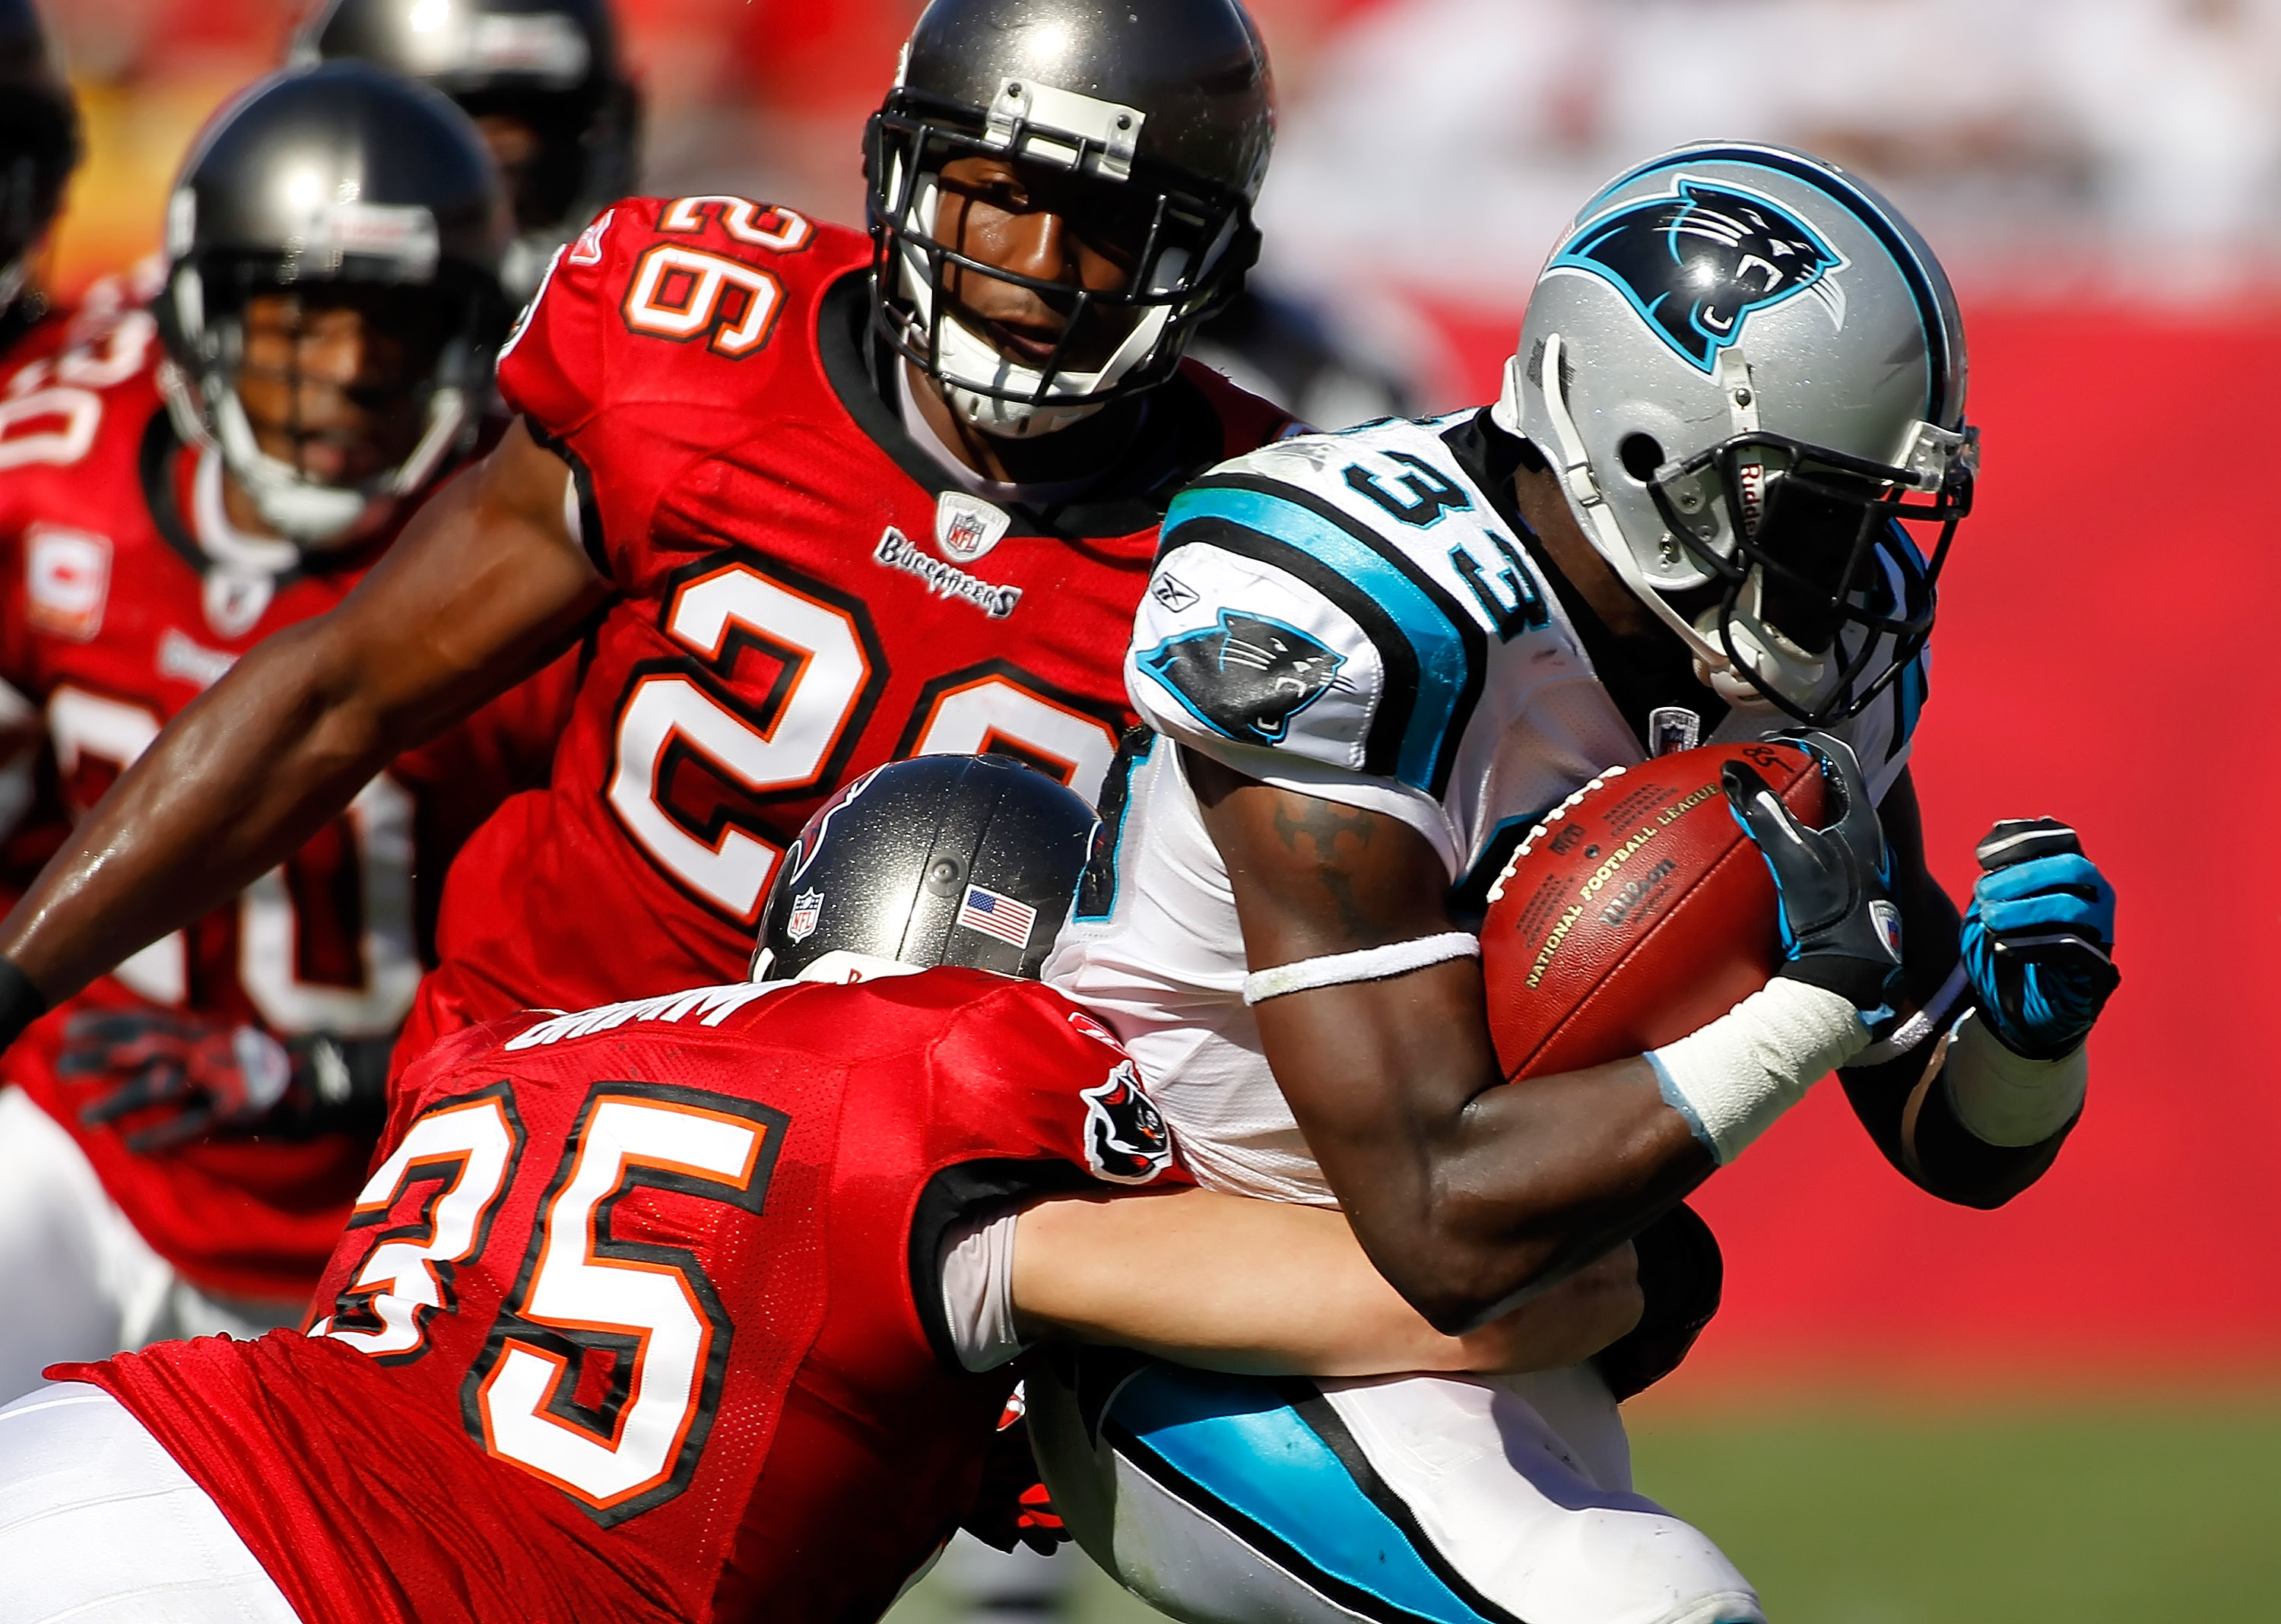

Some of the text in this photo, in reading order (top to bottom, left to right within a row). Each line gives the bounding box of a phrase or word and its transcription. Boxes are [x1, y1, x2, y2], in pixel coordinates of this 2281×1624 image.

[620, 195, 818, 361] 26
[1341, 449, 1551, 644] 33
[1742, 746, 1795, 773] 85
[791, 911, 814, 933] NFL
[1524, 904, 1584, 990] NATIONAL
[1579, 826, 1659, 901] FOOTBALL
[1656, 782, 1721, 826] LEAGUE
[1597, 858, 1677, 926] Wilson
[306, 1080, 791, 1530] 35
